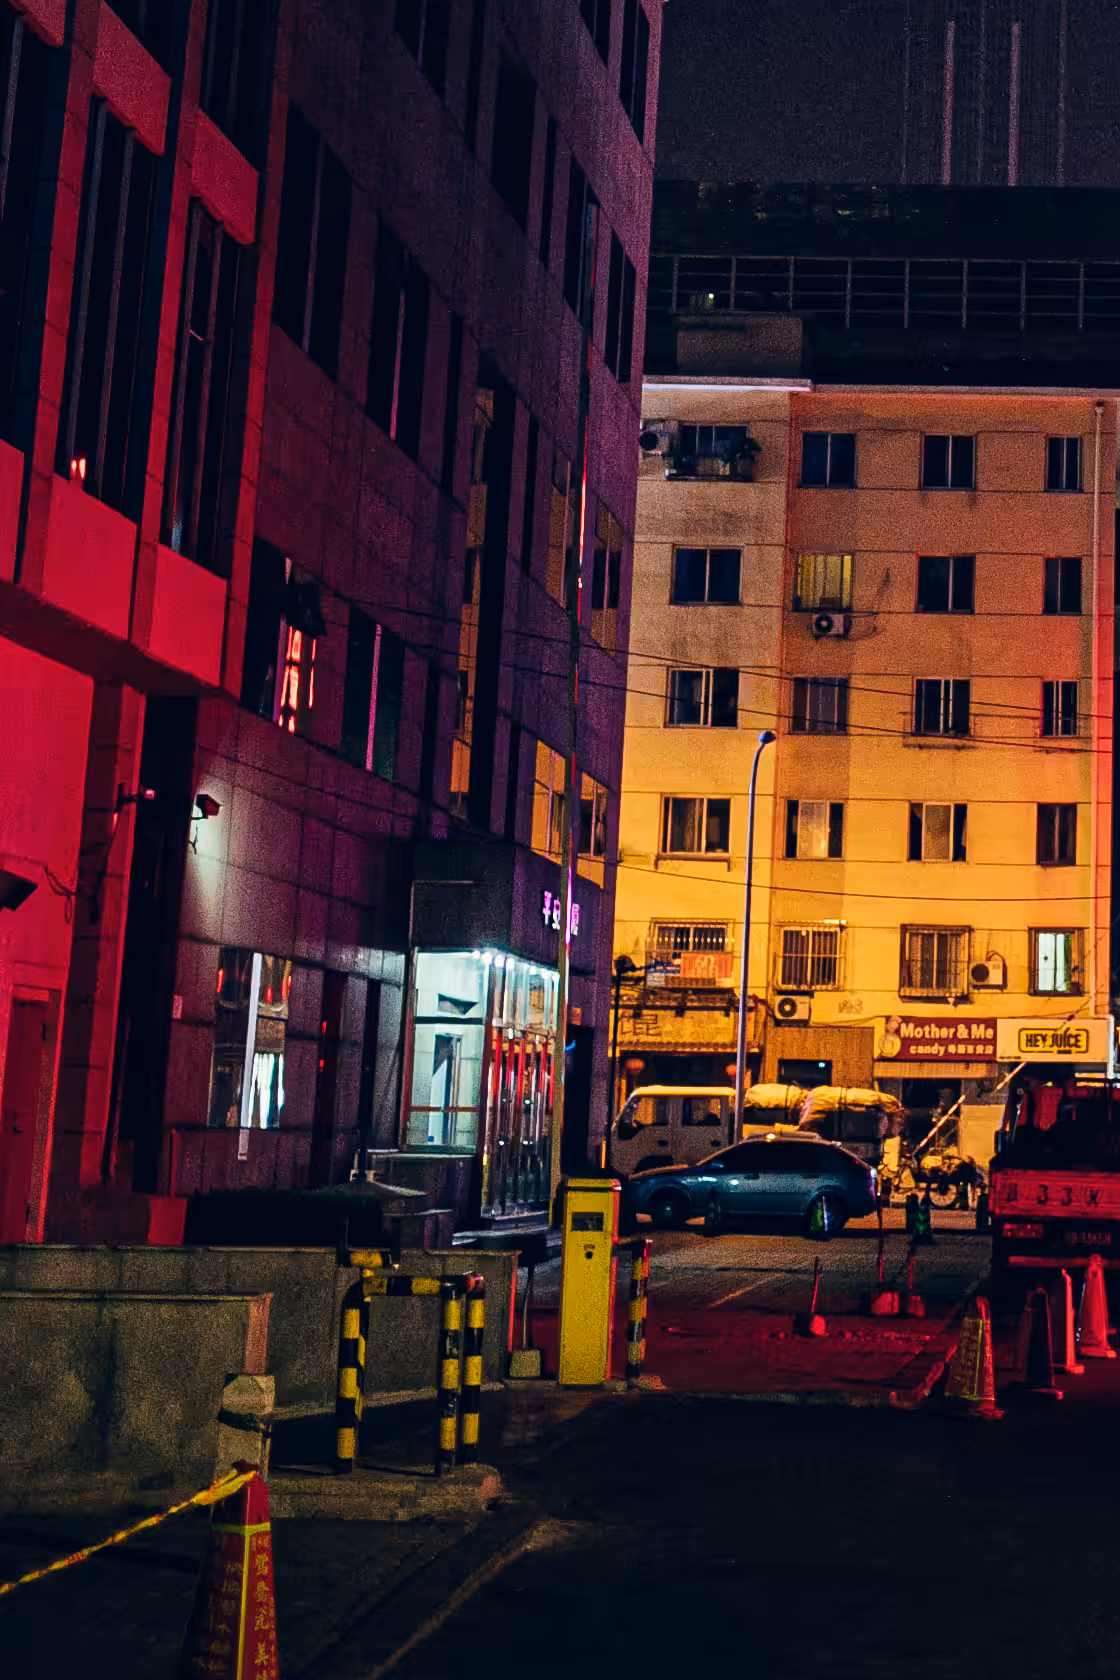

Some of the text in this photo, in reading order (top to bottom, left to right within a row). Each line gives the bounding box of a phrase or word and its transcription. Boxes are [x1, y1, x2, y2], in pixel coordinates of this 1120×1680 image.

[1025, 1028, 1082, 1048] HEY JUICE
[909, 1042, 945, 1058] candy
